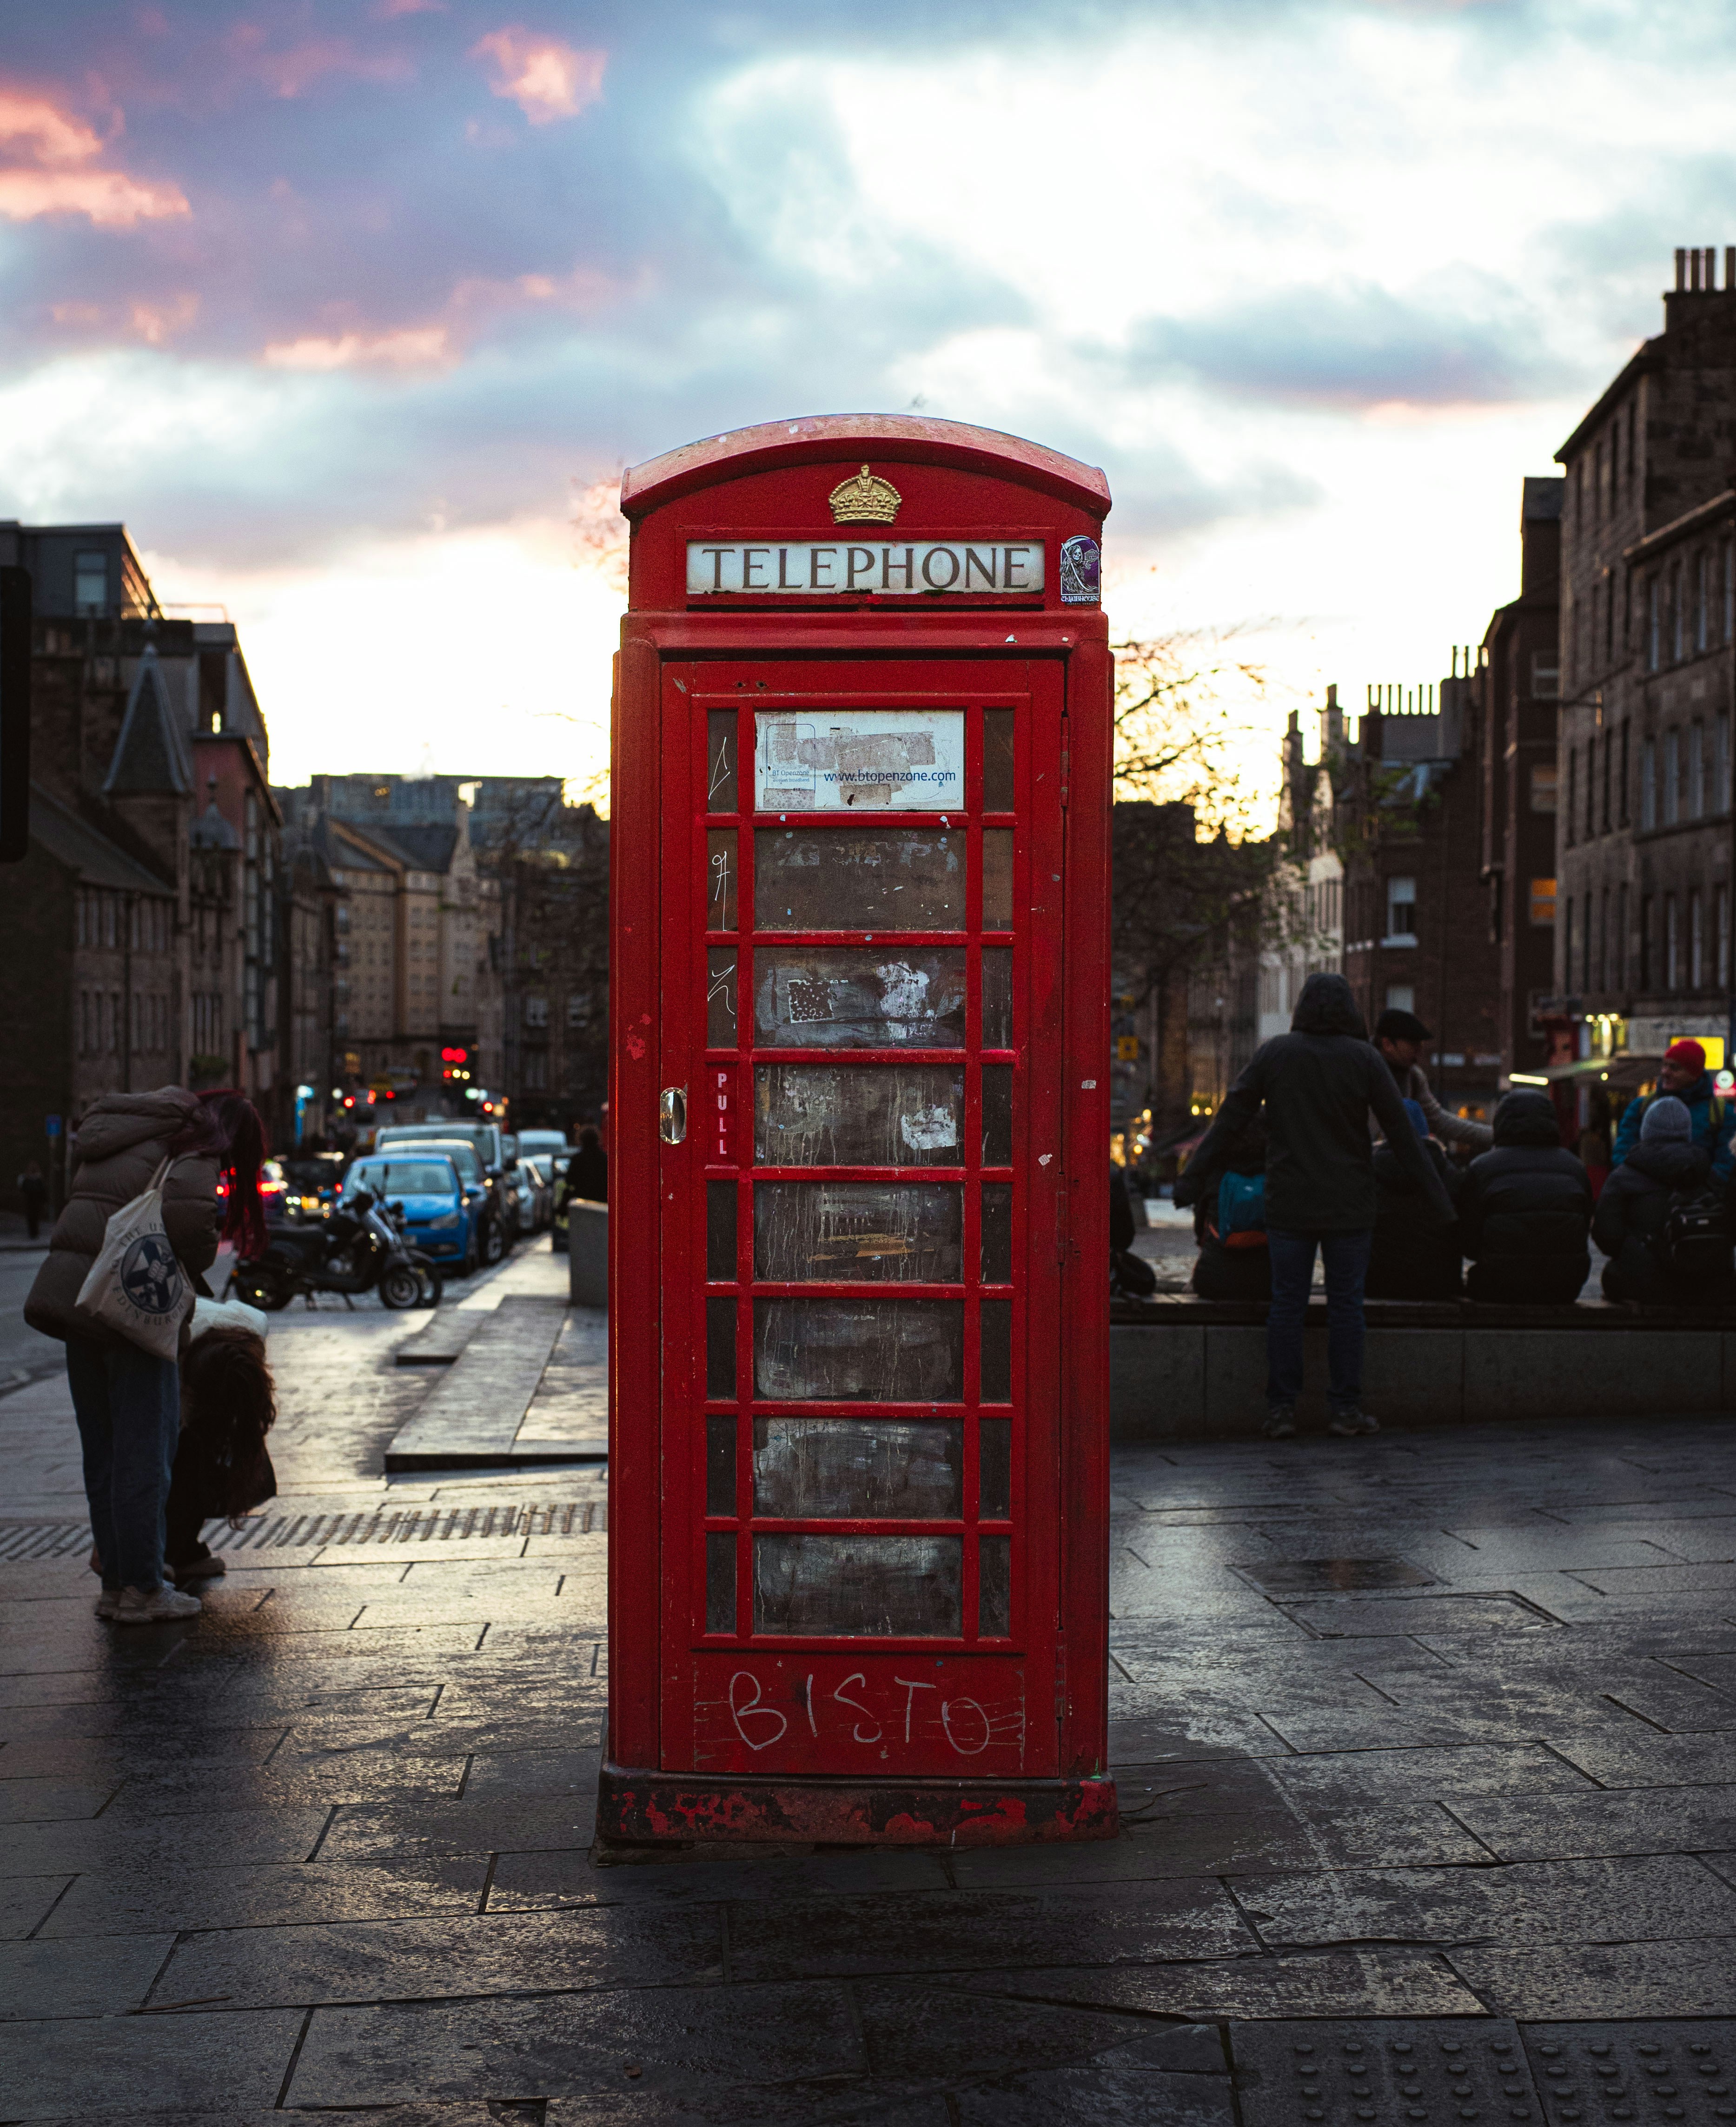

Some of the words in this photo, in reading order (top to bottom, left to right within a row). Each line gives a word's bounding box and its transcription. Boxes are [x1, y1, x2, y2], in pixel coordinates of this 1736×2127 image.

[702, 547, 1030, 590] TELEPHONE
[824, 769, 956, 784] www.btopenzone.com
[717, 1073, 728, 1155] PULL
[729, 1670, 990, 1756] BISTO
